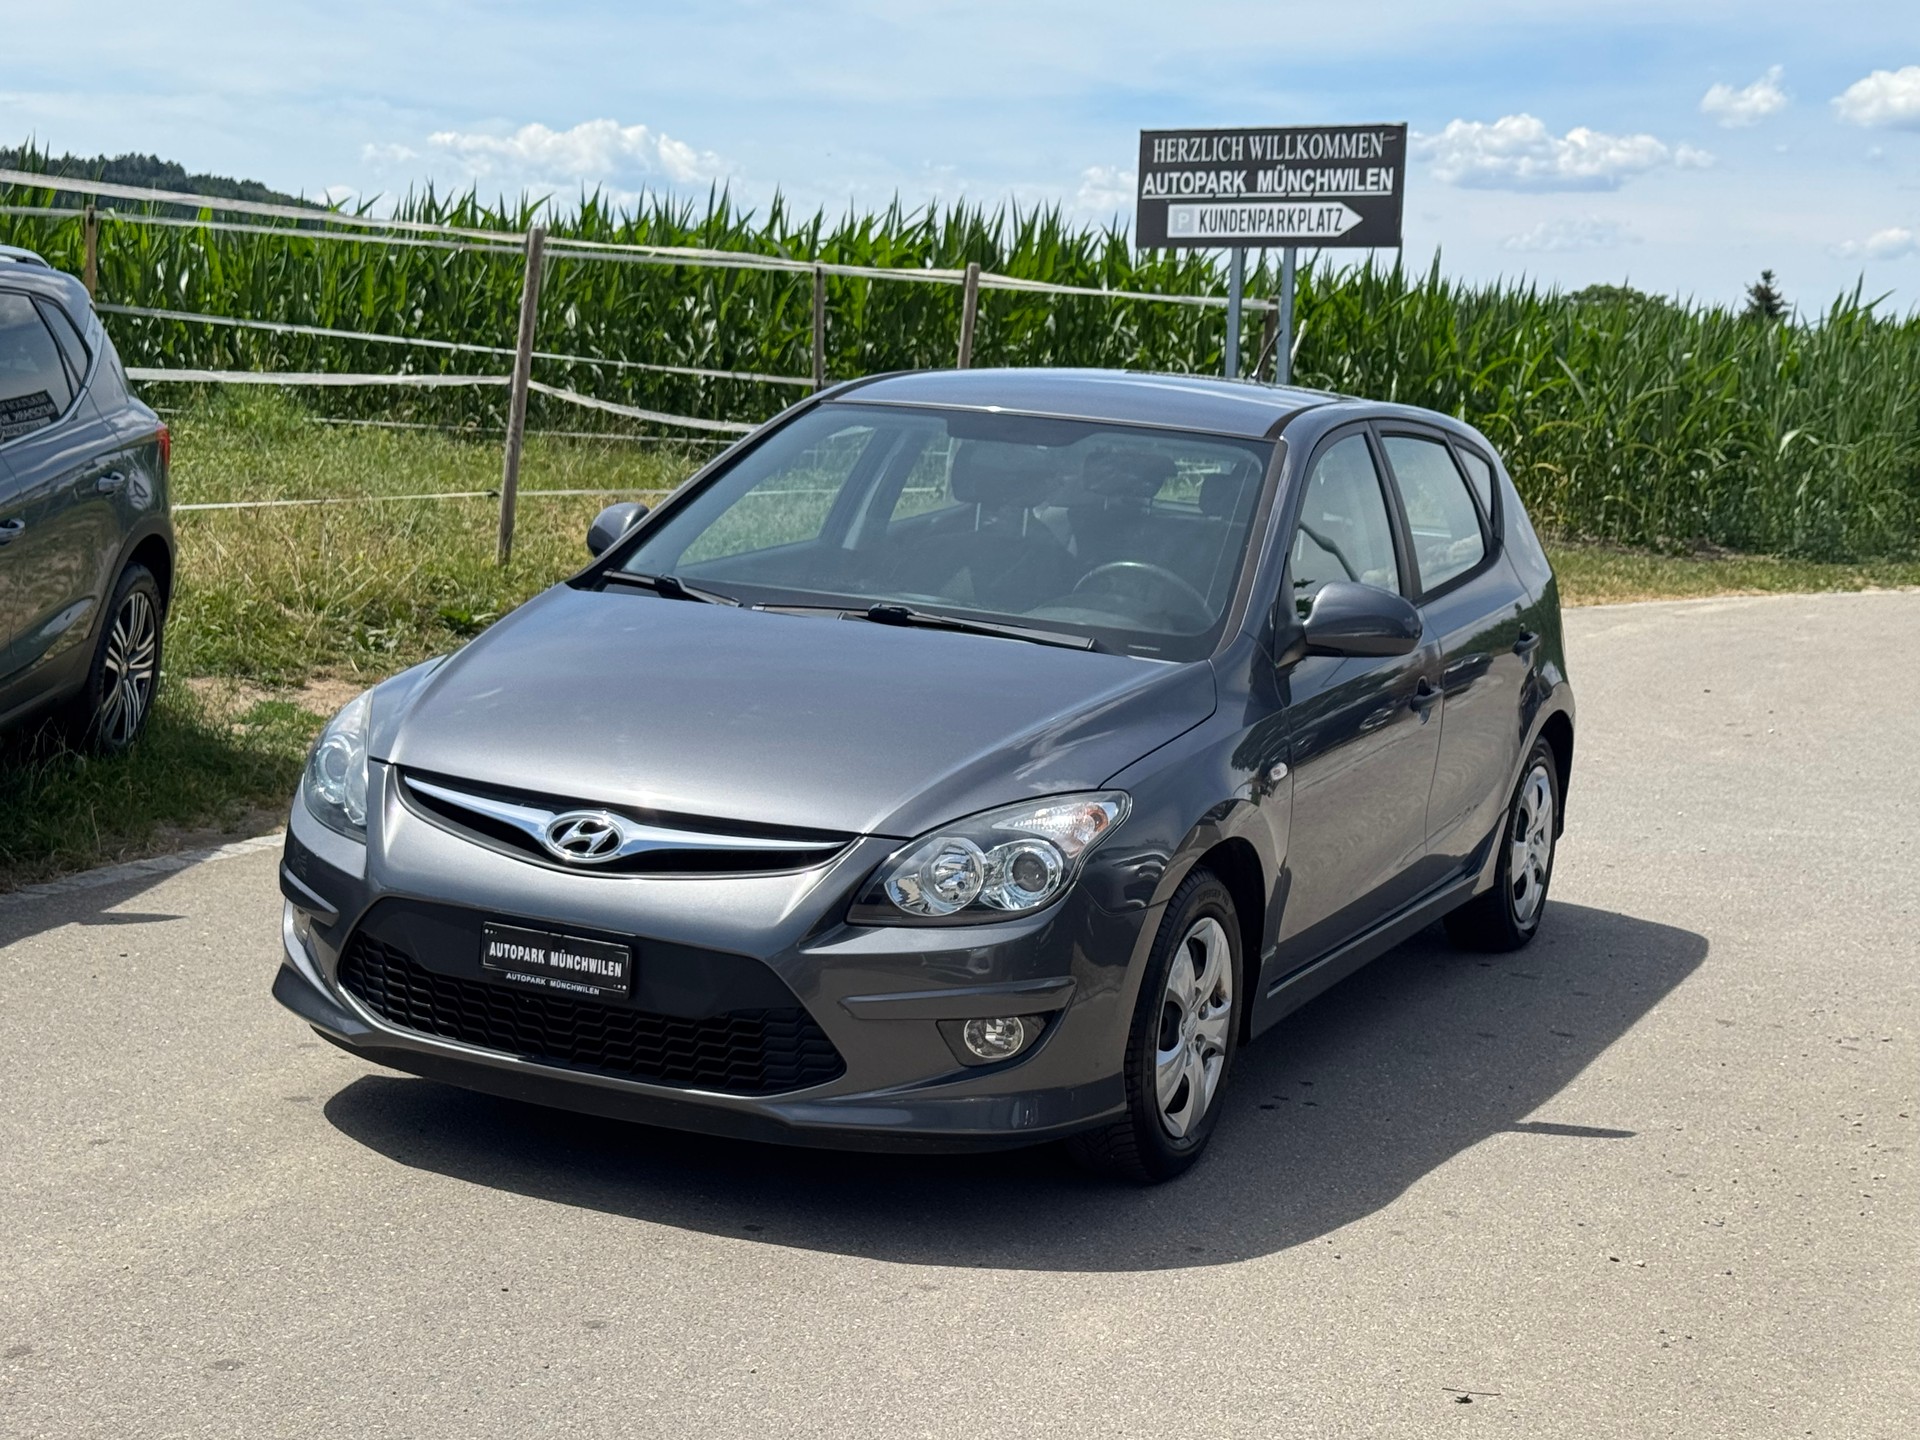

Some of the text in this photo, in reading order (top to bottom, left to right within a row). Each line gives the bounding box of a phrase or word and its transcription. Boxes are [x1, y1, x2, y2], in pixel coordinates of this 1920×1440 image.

[1153, 132, 1384, 163] HERZLICH WILLKOMMEN
[1142, 164, 1394, 194] AUTOPARK MÜNCHWILEN
[1198, 208, 1343, 233] KUNDENPARKPLATZ
[489, 941, 622, 977] AUTOPARK MÜNCHWILEN
[506, 972, 600, 995] AUTOPARK MÜNCHWILEN
